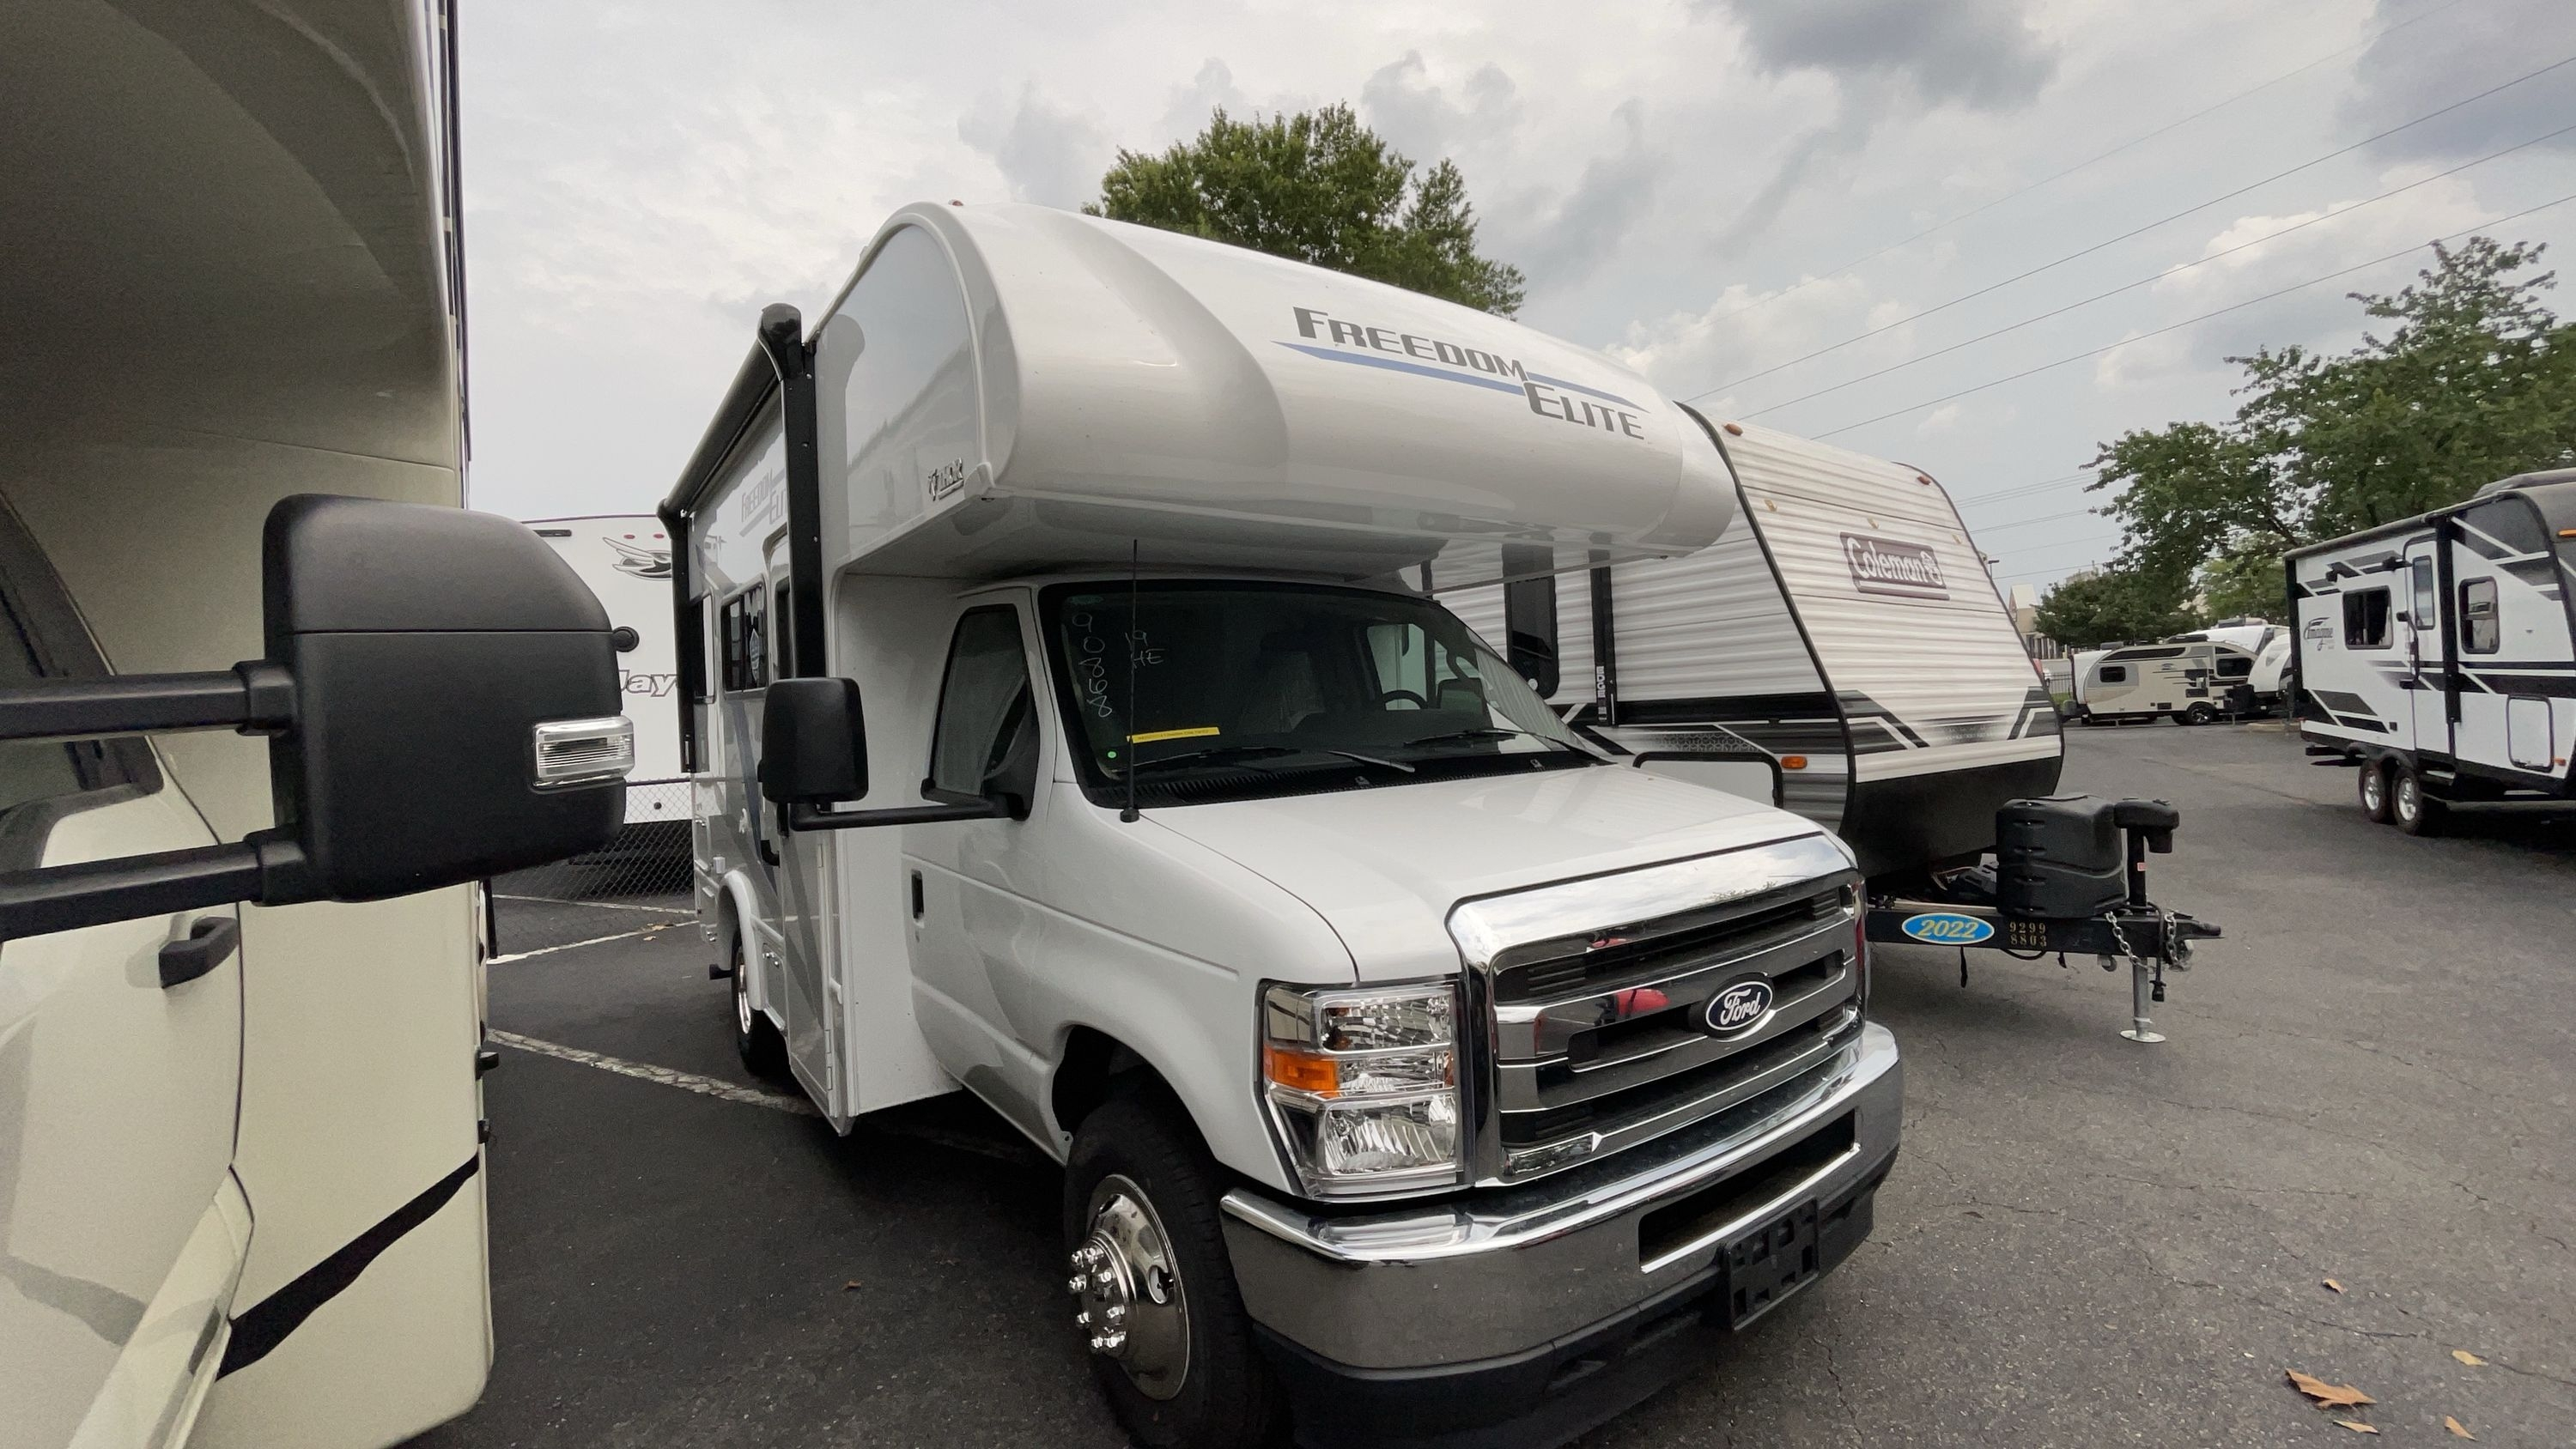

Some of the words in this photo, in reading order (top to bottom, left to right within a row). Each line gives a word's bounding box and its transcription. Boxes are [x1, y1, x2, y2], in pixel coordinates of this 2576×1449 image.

[1292, 306, 1528, 382] FREEDOM
[1523, 380, 1645, 440] ELITE
[1847, 537, 1929, 584] Coleman
[1917, 919, 1979, 938] 2022
[2009, 921, 2047, 934] 9299
[2010, 934, 2047, 947] 8803
[1720, 988, 1762, 1026] Ford
